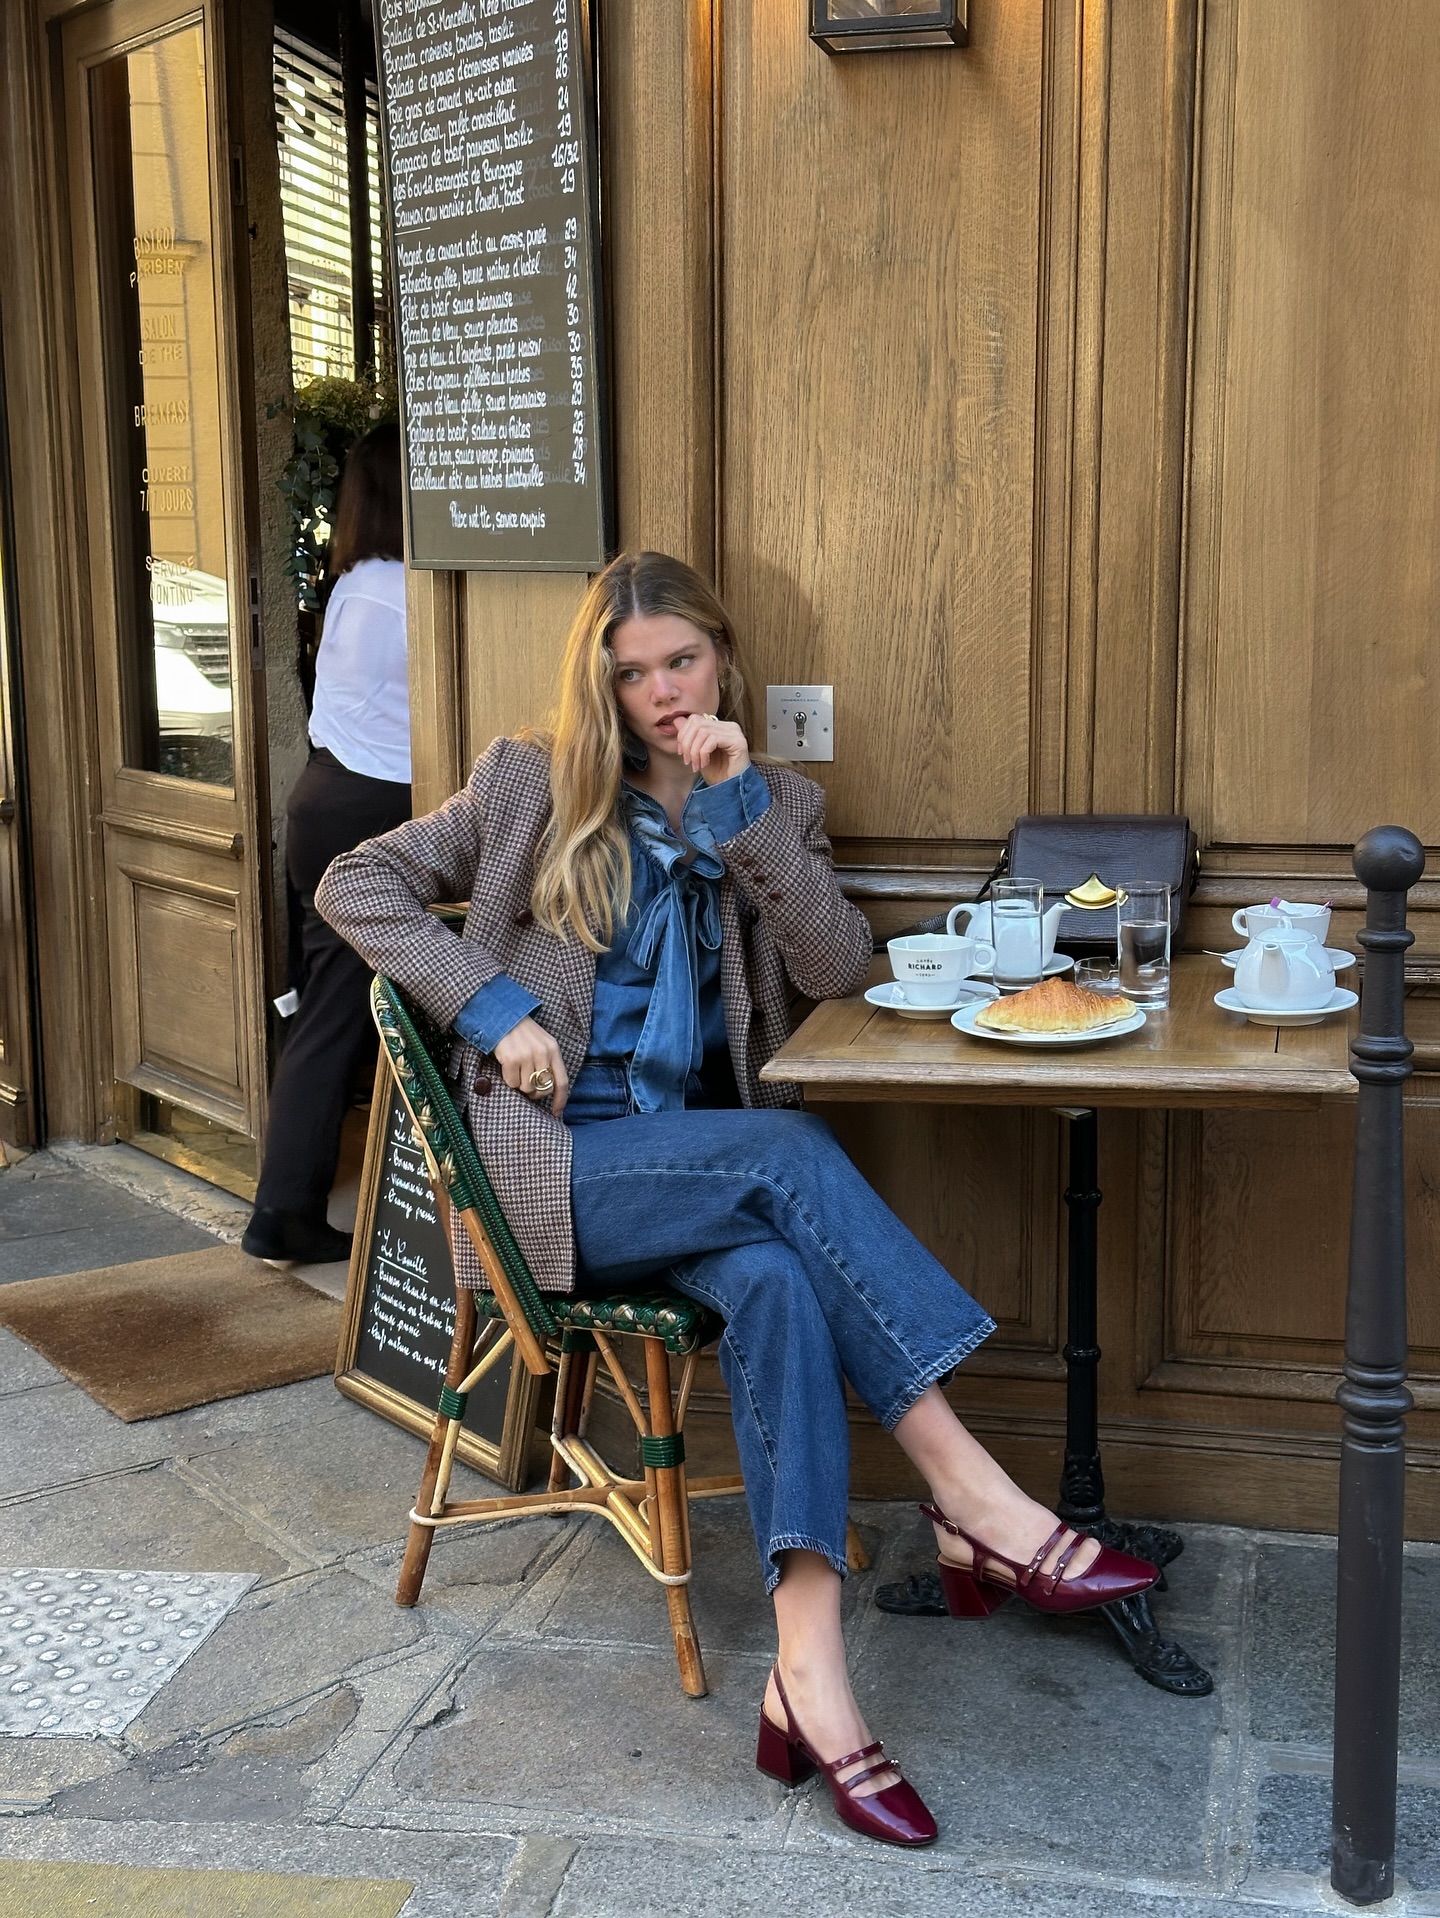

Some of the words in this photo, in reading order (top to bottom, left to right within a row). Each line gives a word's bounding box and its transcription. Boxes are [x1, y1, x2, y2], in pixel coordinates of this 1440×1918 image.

[382, 19, 413, 49] Salade
[416, 16, 426, 39] de
[383, 46, 418, 74] Burrata
[488, 15, 514, 44] basilic
[552, 0, 567, 25] 19
[386, 74, 414, 99] Salade
[418, 70, 428, 92] de
[430, 67, 455, 97] queues
[502, 41, 533, 68] marinées
[555, 28, 568, 53] 18
[387, 100, 403, 125] Foie
[405, 102, 422, 129] gras
[425, 97, 435, 115] de
[437, 87, 462, 112] canard
[556, 53, 568, 79] 26
[390, 125, 418, 150] Salade
[448, 110, 470, 149] poulet
[471, 99, 516, 131] croustillant
[557, 86, 569, 110] 24
[391, 151, 428, 182] Carpaccio
[431, 145, 441, 166] de
[504, 120, 533, 149] basilic
[557, 112, 571, 137] 19
[407, 173, 413, 198] 6
[414, 182, 422, 197] ou
[422, 174, 434, 195] 12
[435, 167, 469, 199] escargots
[471, 165, 480, 185] de
[482, 159, 522, 190] Bourgogne
[552, 140, 579, 168] 16/32
[395, 202, 423, 228] Saumon
[425, 206, 437, 223] cru
[439, 193, 464, 220] mariné
[466, 191, 473, 216] à
[504, 180, 524, 207] toast
[561, 168, 575, 193] 19
[397, 241, 423, 276] Magret
[426, 244, 436, 263] de
[438, 238, 464, 261] canard
[486, 236, 498, 253] au
[564, 217, 577, 240] 29
[129, 258, 184, 288] PARISIEN
[399, 267, 432, 295] Entrecôte
[462, 263, 484, 285] beurre
[564, 246, 577, 269] 34
[400, 295, 419, 321] Filet
[421, 298, 429, 319] de
[452, 298, 474, 315] sauce
[476, 290, 513, 312] béarnaise
[566, 272, 577, 299] 42
[143, 315, 177, 341] SALON
[401, 320, 431, 346] Piccata
[432, 321, 441, 342] de
[464, 320, 484, 338] sauce
[567, 302, 579, 325] 30
[139, 348, 156, 366] DE
[403, 345, 417, 369] Foie
[420, 348, 428, 367] de
[429, 345, 447, 366] veau
[449, 344, 455, 365] à
[518, 337, 542, 358] maison
[568, 330, 580, 352] 30
[405, 367, 424, 392] Côtes
[426, 369, 461, 399] d'agneau
[491, 370, 505, 385] aux
[506, 360, 531, 383] herbes
[570, 355, 582, 379] 35
[134, 399, 190, 428] BREAKFAST
[406, 392, 432, 420] Rognon
[434, 397, 443, 415] de
[443, 393, 460, 414] veau
[485, 394, 506, 411] sauce
[508, 387, 546, 410] béarnaise
[571, 380, 582, 405] 29
[407, 417, 434, 442] Tartare
[436, 422, 445, 442] de
[471, 418, 497, 440] salade
[499, 424, 507, 439] ou
[508, 415, 531, 439] frites
[572, 409, 583, 434] 26
[409, 443, 426, 466] Filet
[429, 445, 437, 466] de
[455, 448, 475, 465] sauce
[502, 440, 534, 472] épinards
[572, 435, 583, 460] 28
[142, 466, 188, 483] OUVERT
[410, 466, 447, 490] Cabillaud
[465, 475, 478, 489] aux
[480, 467, 502, 489] herbes
[505, 463, 544, 488] ratatouille
[573, 461, 586, 485] 34
[160, 488, 194, 511] JOURS
[495, 511, 519, 528] service
[145, 555, 196, 578] SERVICE
